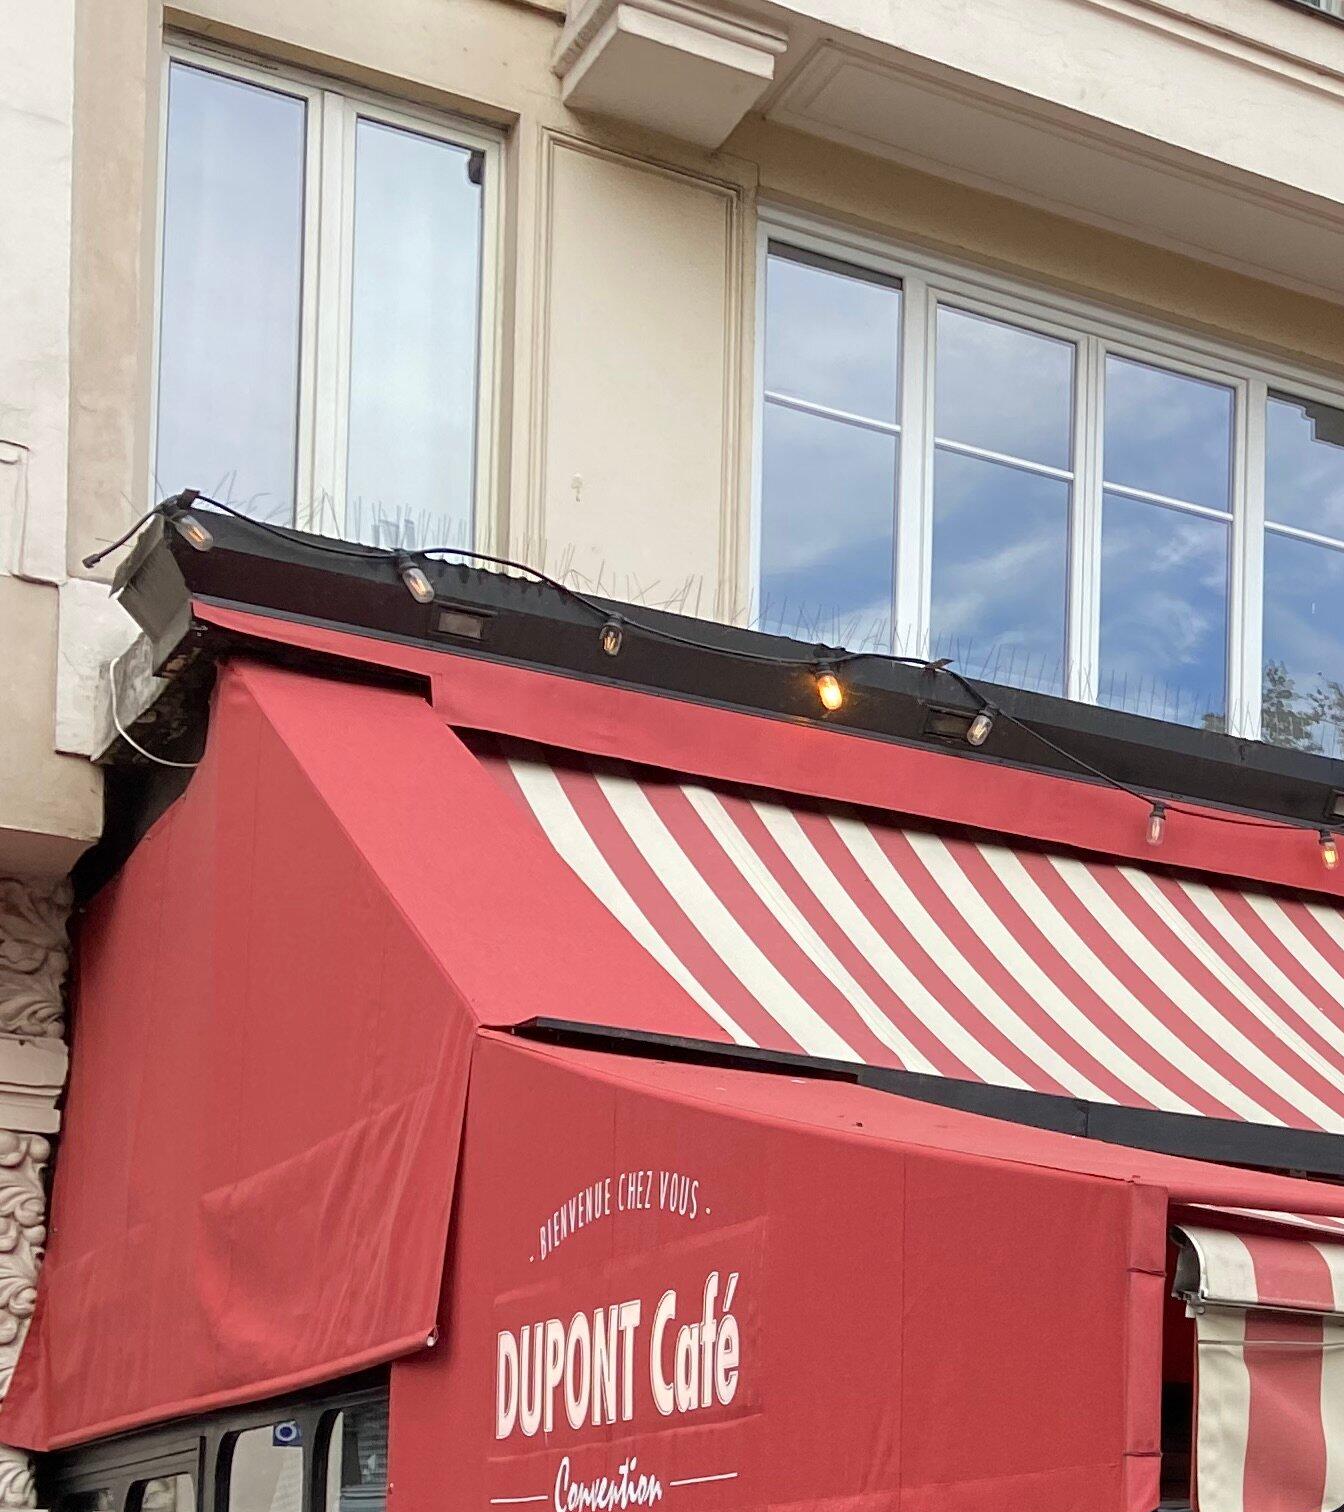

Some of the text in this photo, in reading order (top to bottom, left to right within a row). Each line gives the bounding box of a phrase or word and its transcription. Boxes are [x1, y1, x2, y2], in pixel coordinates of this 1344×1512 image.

[540, 1170, 700, 1261] BIENVENUE CHEZ VOUS
[496, 1271, 740, 1440] DUPONT Café
